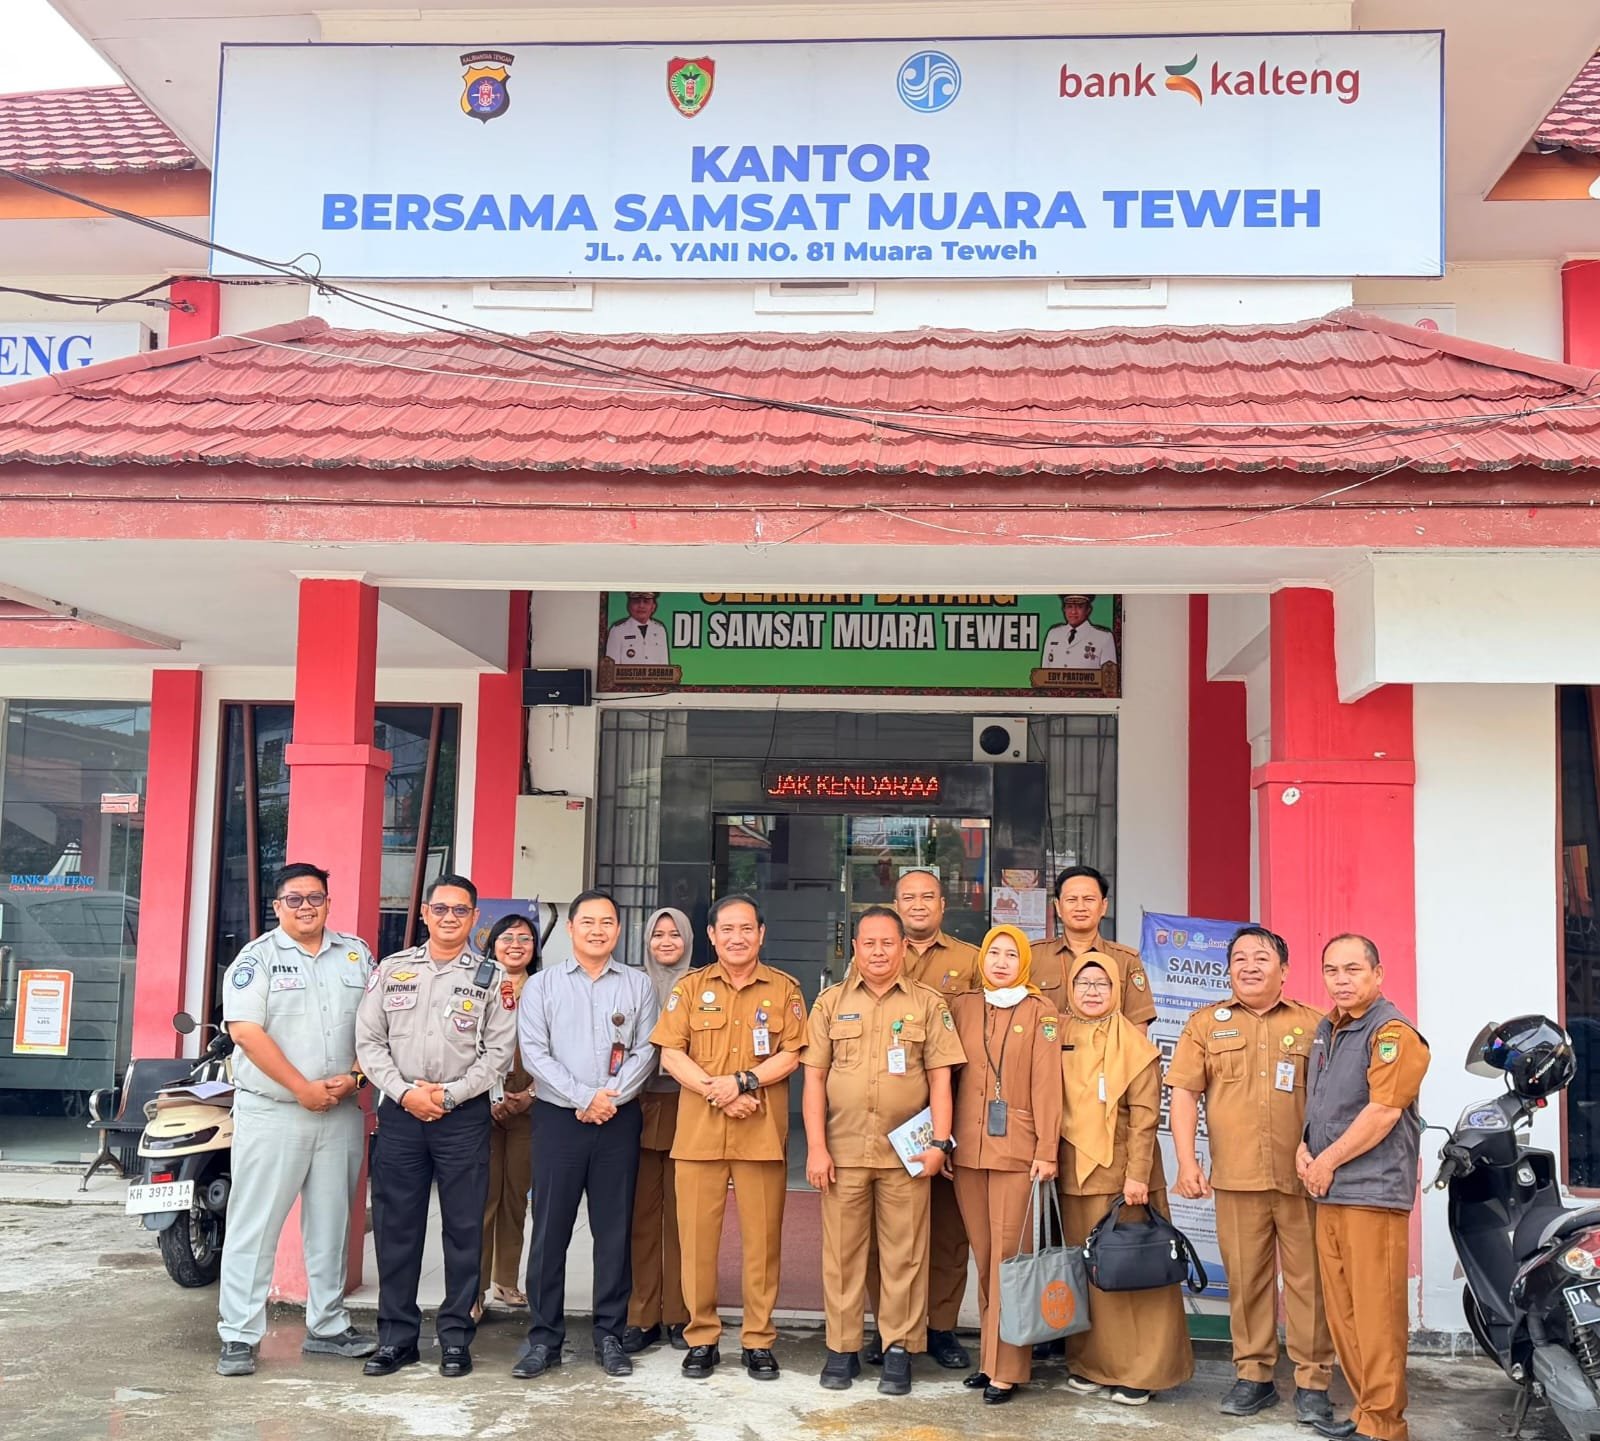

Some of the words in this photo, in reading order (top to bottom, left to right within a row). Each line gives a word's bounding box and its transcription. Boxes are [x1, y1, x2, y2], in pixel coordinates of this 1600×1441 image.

[1059, 62, 1157, 99] bank
[1210, 60, 1360, 104] kalteng
[692, 144, 930, 183] KANTOR
[323, 193, 596, 231] BERSAMA
[614, 193, 851, 232] SAMSAT
[869, 191, 1085, 231] MUARA
[1103, 189, 1320, 229] TEWEH
[586, 243, 625, 262] JL.
[633, 243, 661, 262] A.
[673, 243, 738, 262] YANI
[748, 243, 798, 262] NO.
[807, 242, 835, 262] 81
[844, 242, 933, 262] Muara
[942, 240, 1036, 261] Teweh
[0, 336, 94, 376] ENG
[674, 613, 701, 648] DI
[709, 613, 825, 648] SAMSAT
[833, 613, 935, 649] MUARA
[943, 614, 1038, 650] TEWEH
[768, 775, 812, 795] JAK
[10, 874, 41, 885] BANK
[271, 964, 299, 974] RISKY
[1166, 974, 1208, 987] MUARA
[454, 987, 487, 1000] POLRI
[129, 1188, 143, 1200] KH
[148, 1186, 174, 1198] 3973
[1568, 1289, 1591, 1305] DA
